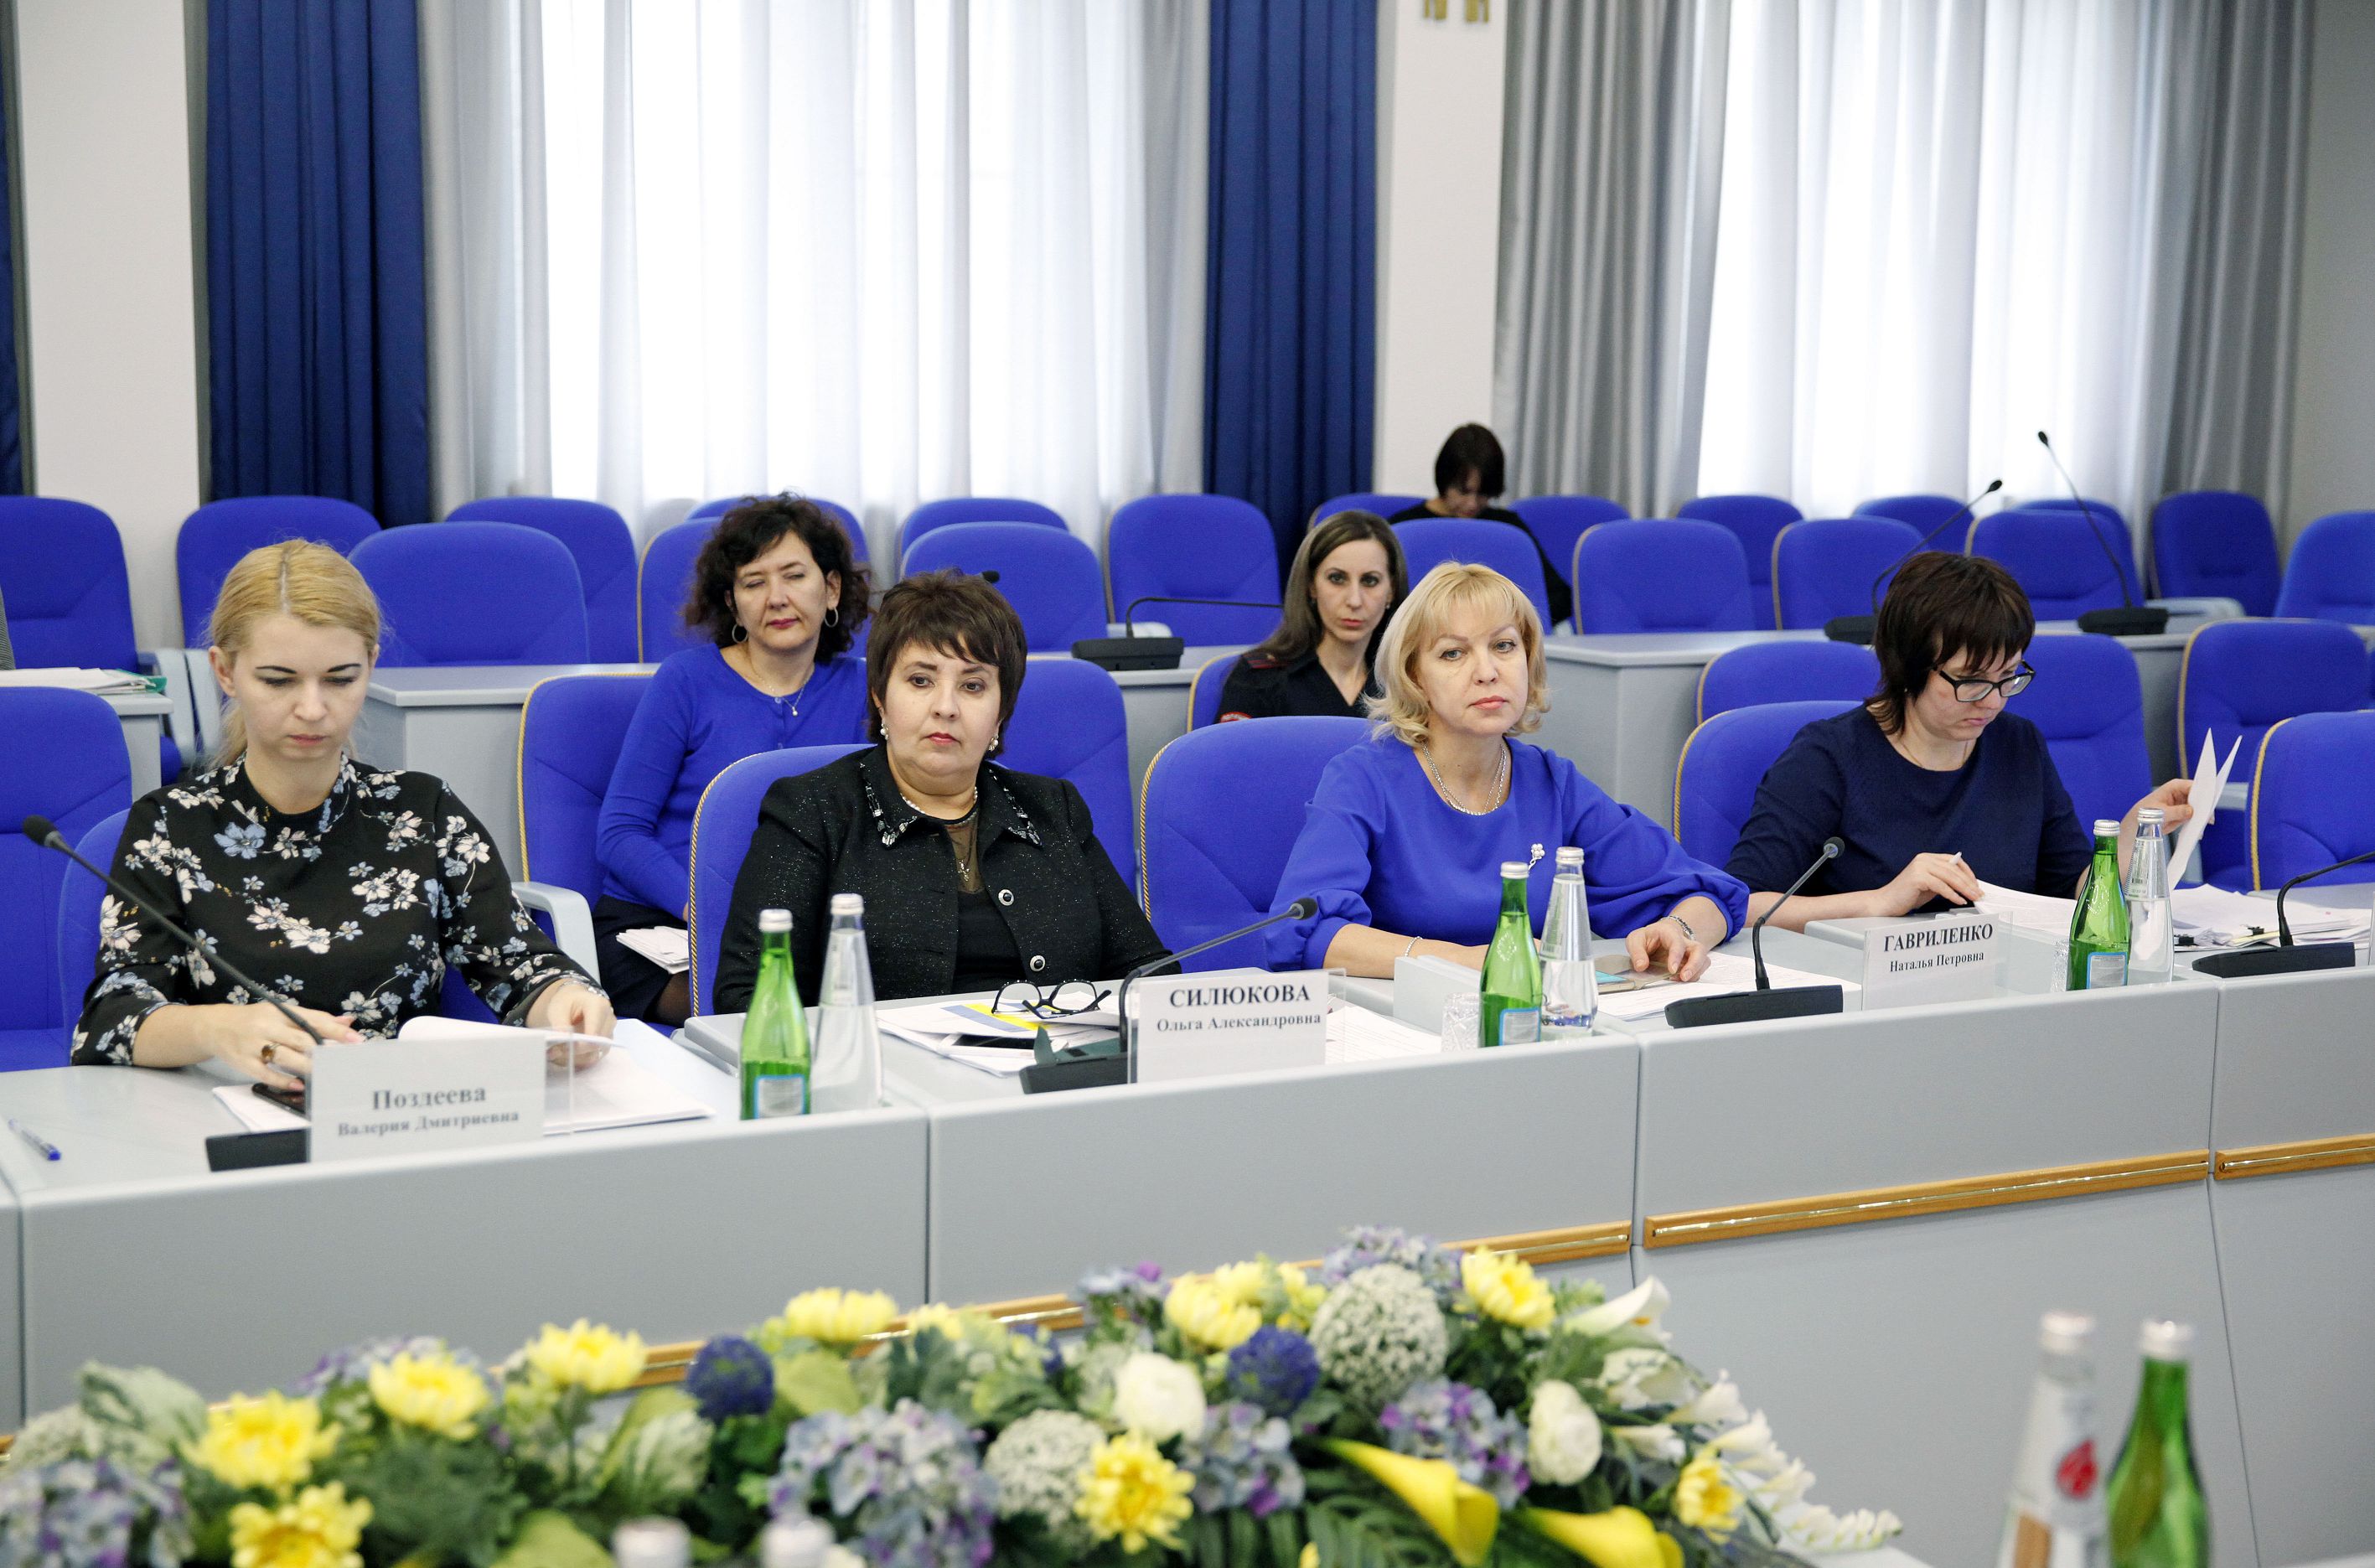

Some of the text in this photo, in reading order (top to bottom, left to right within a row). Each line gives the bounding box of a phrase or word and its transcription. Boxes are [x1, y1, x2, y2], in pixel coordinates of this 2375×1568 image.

[1884, 923, 1993, 952] ГАВРИЛЕНКО
[1890, 952, 1984, 972] Наталья Петровна
[1170, 984, 1310, 1007] СИЛЮКОВА
[1157, 1013, 1321, 1032] Ольга Александровна
[373, 1087, 486, 1110] Поздеева
[339, 1111, 520, 1137] Валерия Дмитриевна
